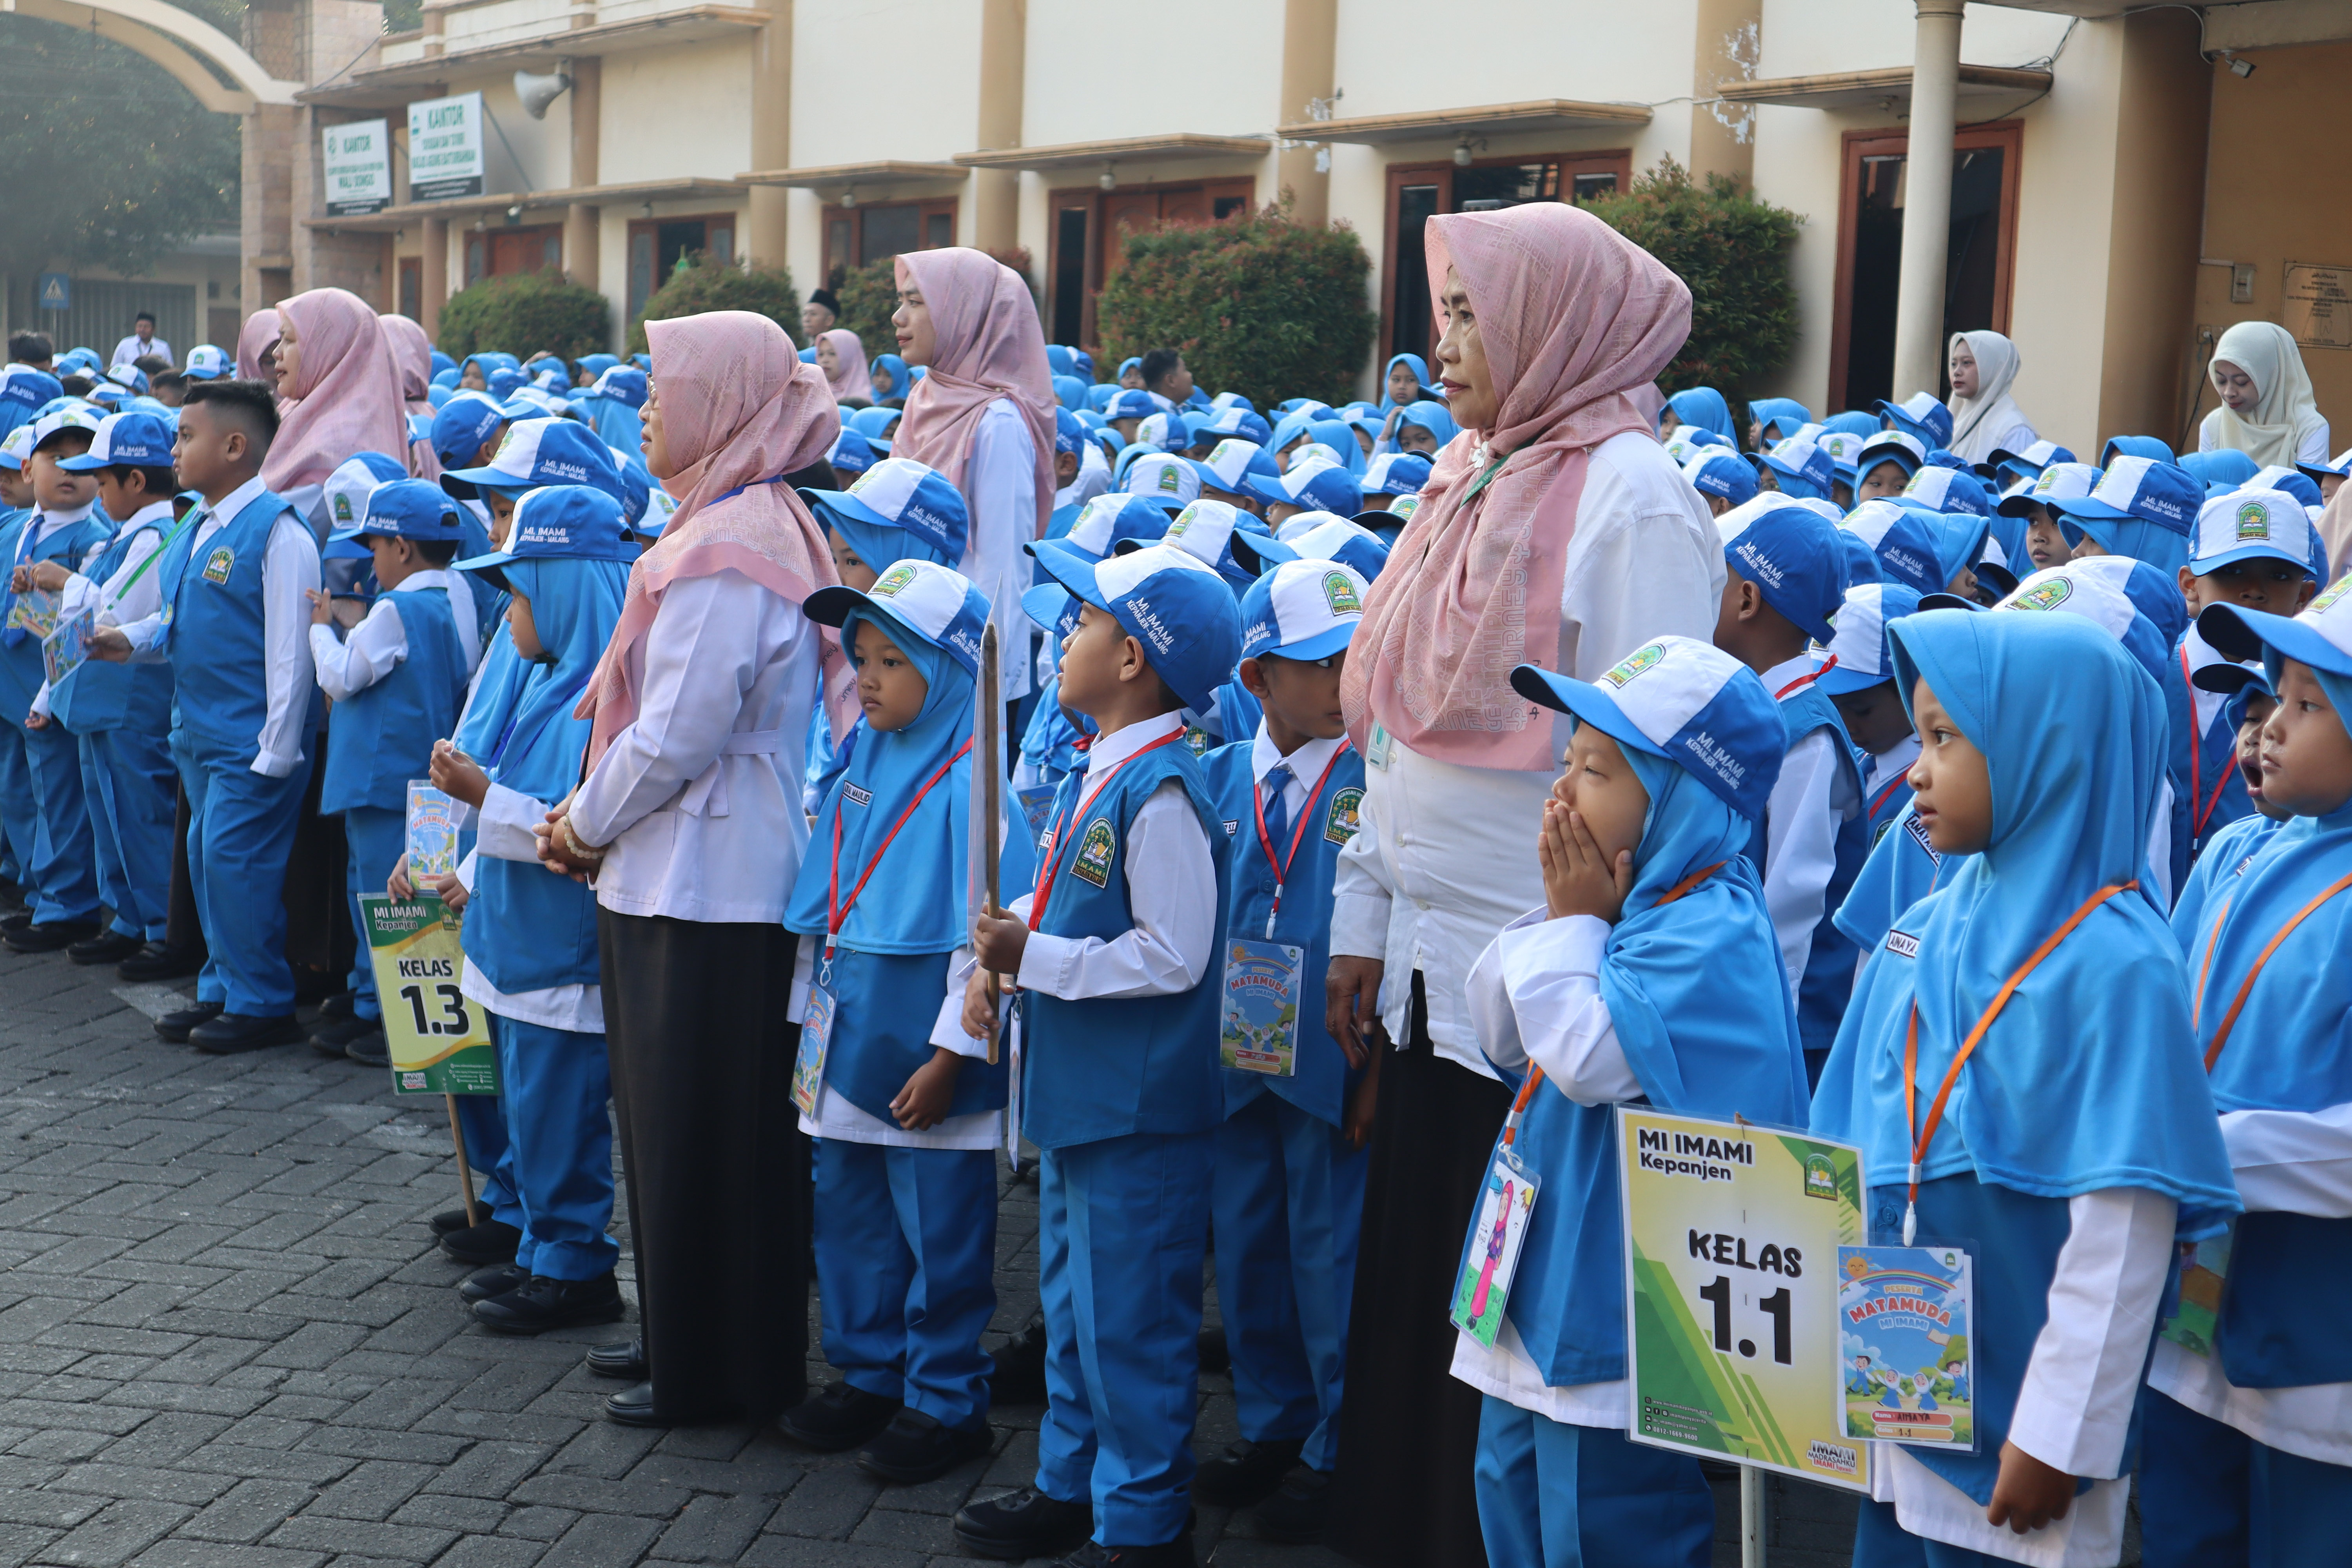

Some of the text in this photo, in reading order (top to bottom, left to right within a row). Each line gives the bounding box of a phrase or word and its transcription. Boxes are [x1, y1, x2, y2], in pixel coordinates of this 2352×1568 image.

[540, 466, 587, 482] KEPANJEN MALANG
[545, 459, 586, 475] MI. IMAMI
[1713, 477, 1730, 488] IMAMI
[2140, 501, 2162, 513] KEPANJEN
[2164, 510, 2182, 520] MALANG
[2145, 495, 2181, 514] MI. IMAMI
[378, 517, 397, 526] IMAMI
[913, 505, 947, 530] MI. IMAMI
[524, 527, 566, 536] MI. IMAMI
[548, 535, 569, 544] MALANG
[1736, 545, 1759, 570] KEPANJEN
[1759, 570, 1781, 589] MALANG
[1744, 541, 1784, 581] MI. IMAMI
[1884, 552, 1905, 567] KEPANJEN
[1907, 564, 1924, 578] MALANG
[1890, 547, 1924, 572] MI. IMAMI
[1126, 600, 1147, 630] KEPANJEN
[1148, 630, 1168, 655] MALANG
[1136, 597, 1175, 646] MI. IMAMI
[950, 633, 971, 654] KEPANJEN
[956, 629, 967, 644] MI.
[1686, 737, 1716, 771] KEPANJEN
[1718, 769, 1740, 791] MALANG
[1697, 731, 1746, 780] MI. IMAMI
[374, 906, 426, 918] MI IMAMI
[376, 920, 418, 931] Kepanjen
[399, 960, 452, 977] KELAS
[1230, 976, 1289, 997] MATAMUDA
[1256, 990, 1275, 999] IMAMI
[400, 984, 469, 1035] 1.3
[1639, 1129, 1752, 1165] MI IMAMI
[1641, 1152, 1731, 1181] Kepanjen
[1689, 1229, 1802, 1278] KELAS
[1884, 1285, 1923, 1296] PESERTA
[1700, 1275, 1792, 1365] 1.1
[1849, 1297, 1951, 1327] MATAMUDA
[1879, 1317, 1929, 1331] MI IMAMI
[1653, 1418, 1698, 1431] mi_imami@yahoo.com
[1670, 1412, 1707, 1424] imamipunyacerita
[1653, 1426, 1698, 1441] 0812-1669-9600
[1808, 1452, 1855, 1468] MADRASAHKU
[1812, 1441, 1855, 1461] IMAMI
[1814, 1459, 1835, 1469] IMAMI
